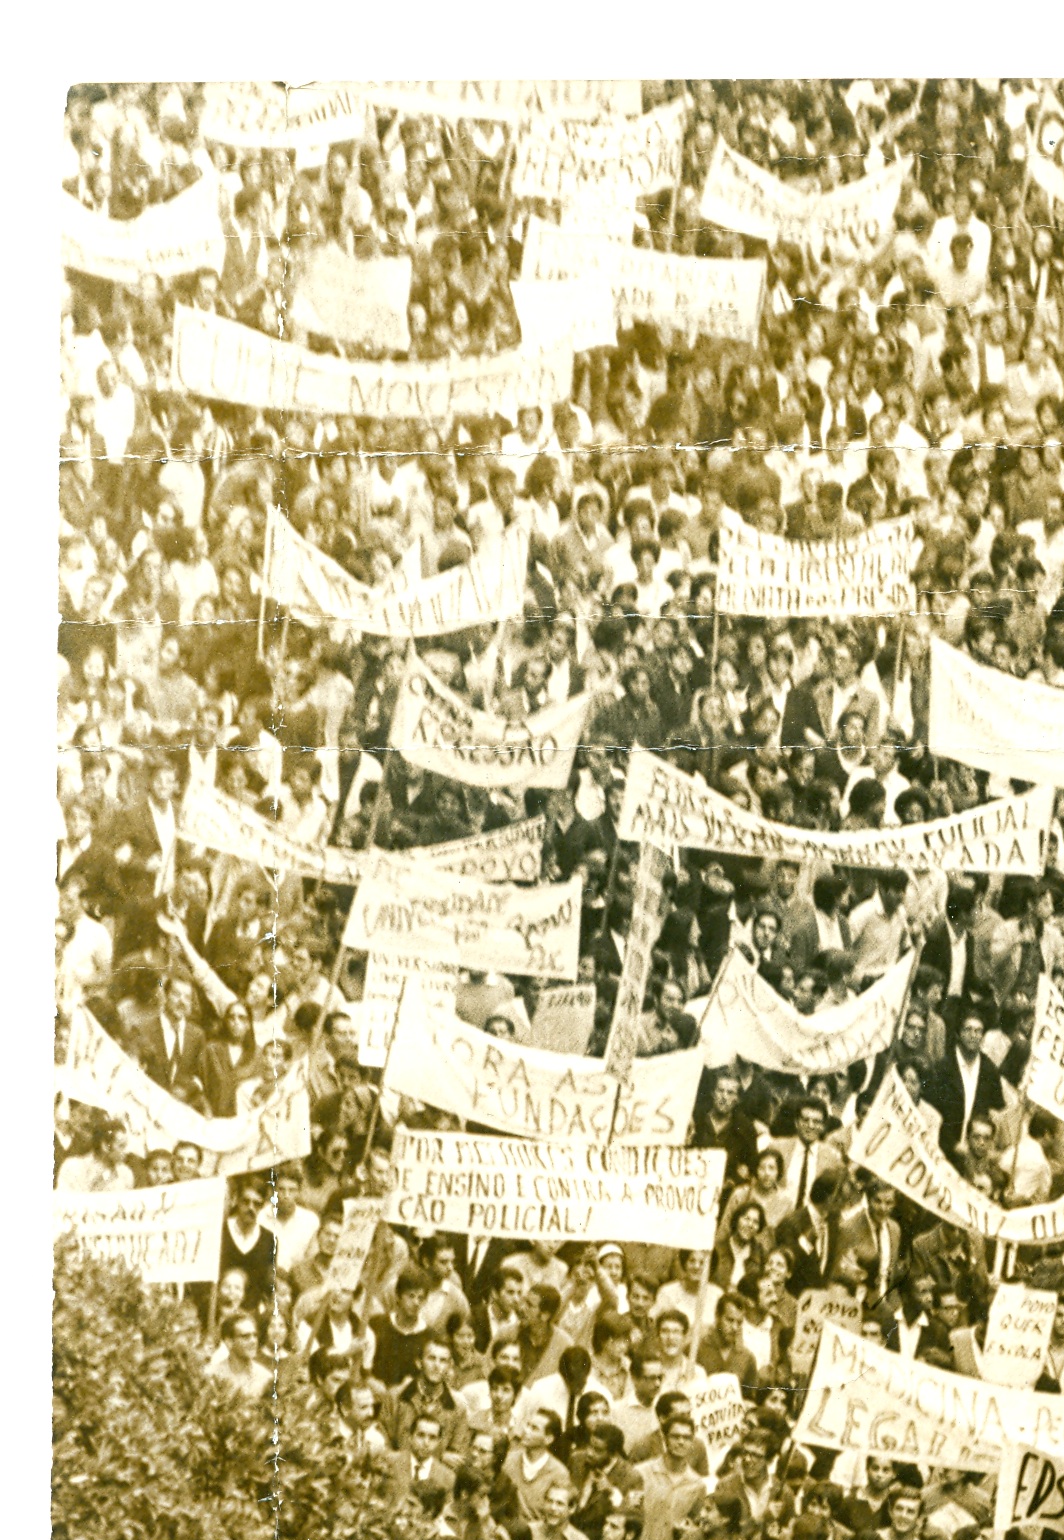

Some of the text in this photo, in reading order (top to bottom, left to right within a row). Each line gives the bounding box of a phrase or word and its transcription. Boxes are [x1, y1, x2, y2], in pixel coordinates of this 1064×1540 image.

[401, 1136, 445, 1165] POR
[425, 1172, 515, 1199] ENSINO
[533, 1176, 612, 1203] CONTRA
[621, 1182, 633, 1203] A
[466, 1202, 594, 1234] POLICIAL!
